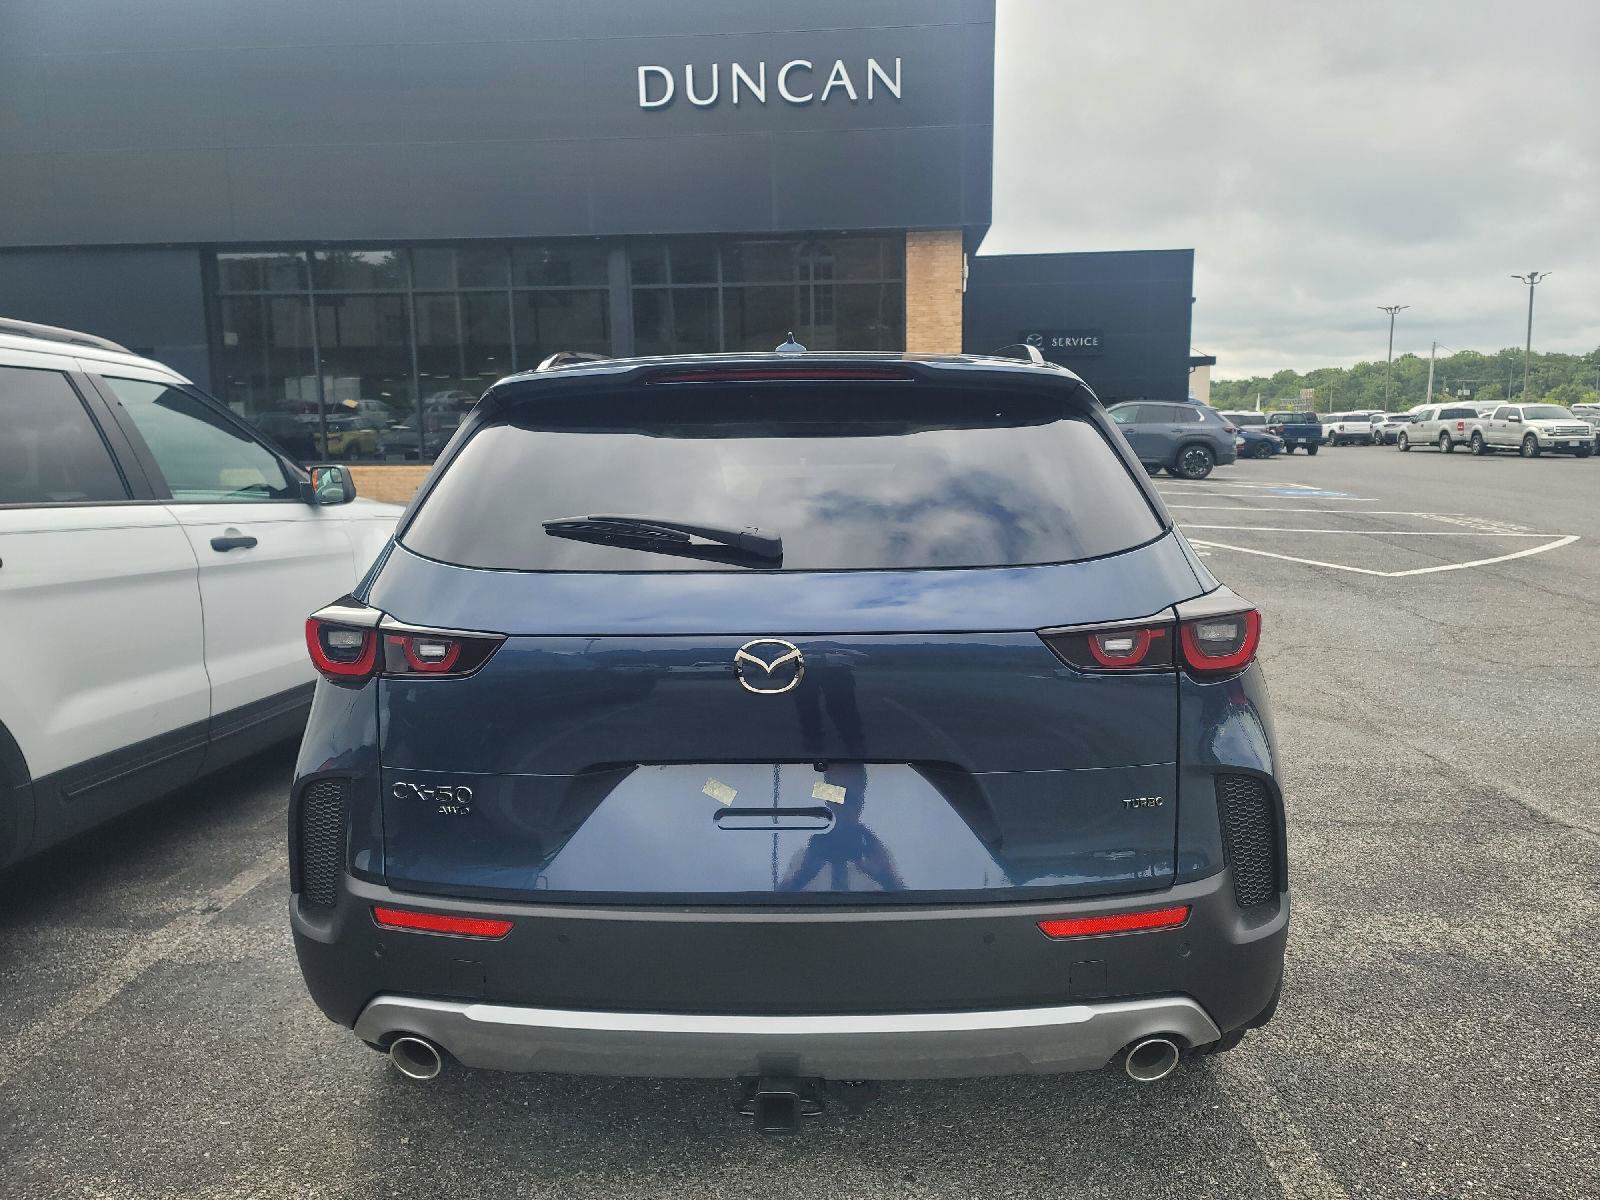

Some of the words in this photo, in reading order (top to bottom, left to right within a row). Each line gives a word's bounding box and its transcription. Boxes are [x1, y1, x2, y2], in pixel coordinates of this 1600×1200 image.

[638, 57, 902, 107] DUNCAN
[1051, 337, 1099, 347] SERVICE
[392, 781, 473, 804] CX-50
[1122, 796, 1163, 809] TURBO
[438, 805, 471, 815] AWD
